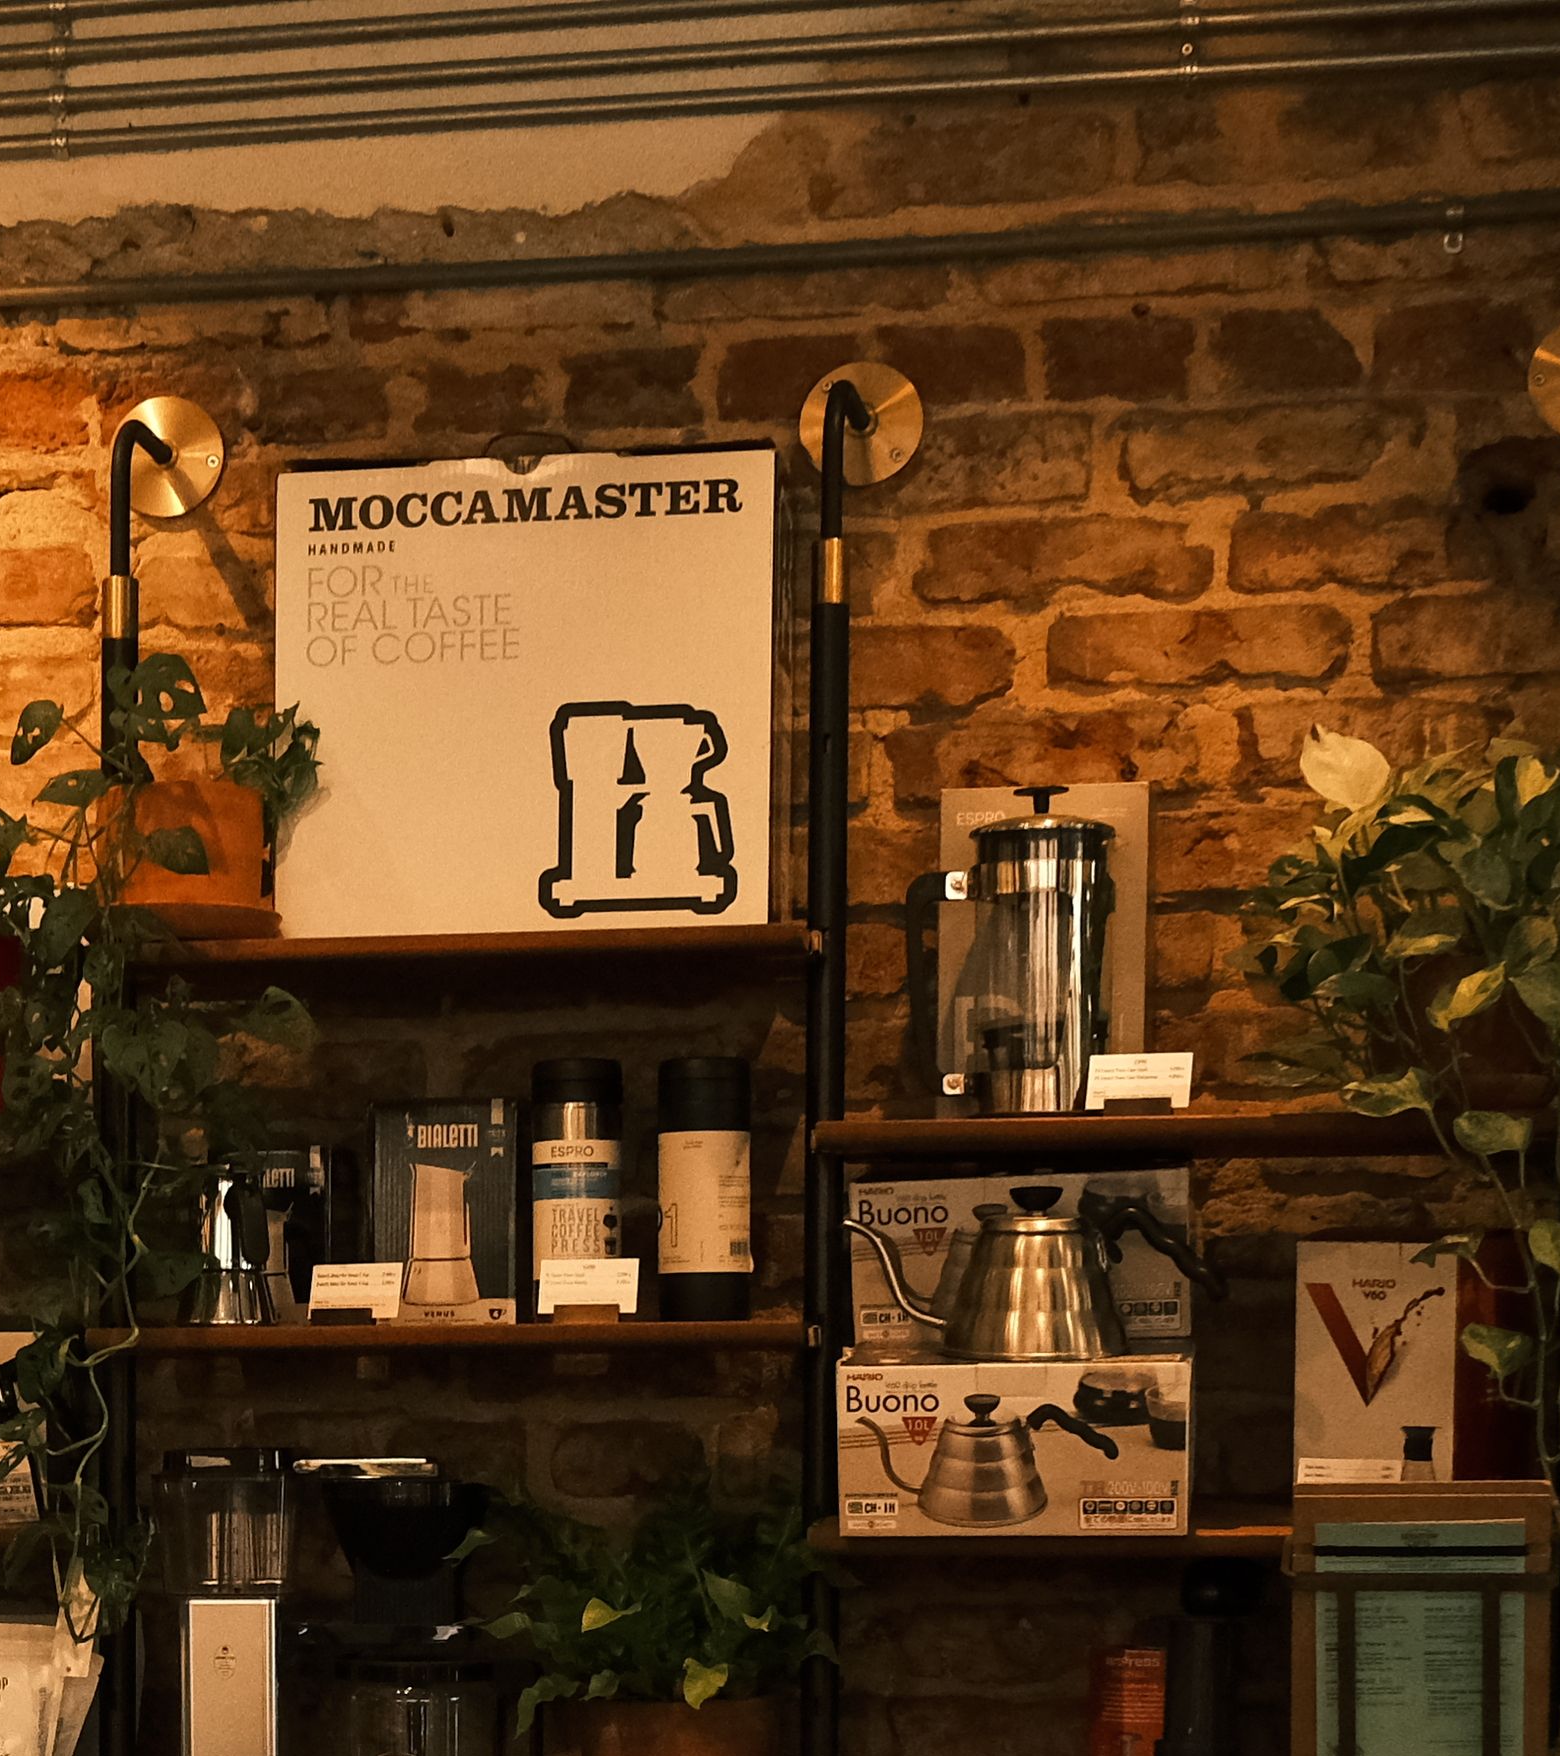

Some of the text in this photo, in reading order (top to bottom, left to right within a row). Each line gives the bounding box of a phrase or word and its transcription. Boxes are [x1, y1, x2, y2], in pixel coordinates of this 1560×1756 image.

[308, 478, 743, 533] MOCCAMASTER
[307, 540, 397, 557] HANDMADE
[306, 565, 435, 599] FOR THE
[306, 593, 513, 633] REAL TASTE
[305, 628, 521, 668] OF COFFEE
[550, 1145, 594, 1158] ESPRO
[551, 1207, 600, 1223] TRAVEL
[858, 1199, 949, 1226] Buono
[551, 1223, 600, 1239] COFFEE
[551, 1239, 601, 1254] PRESS
[1351, 1279, 1396, 1289] HARIO
[846, 1385, 940, 1413] Buono
